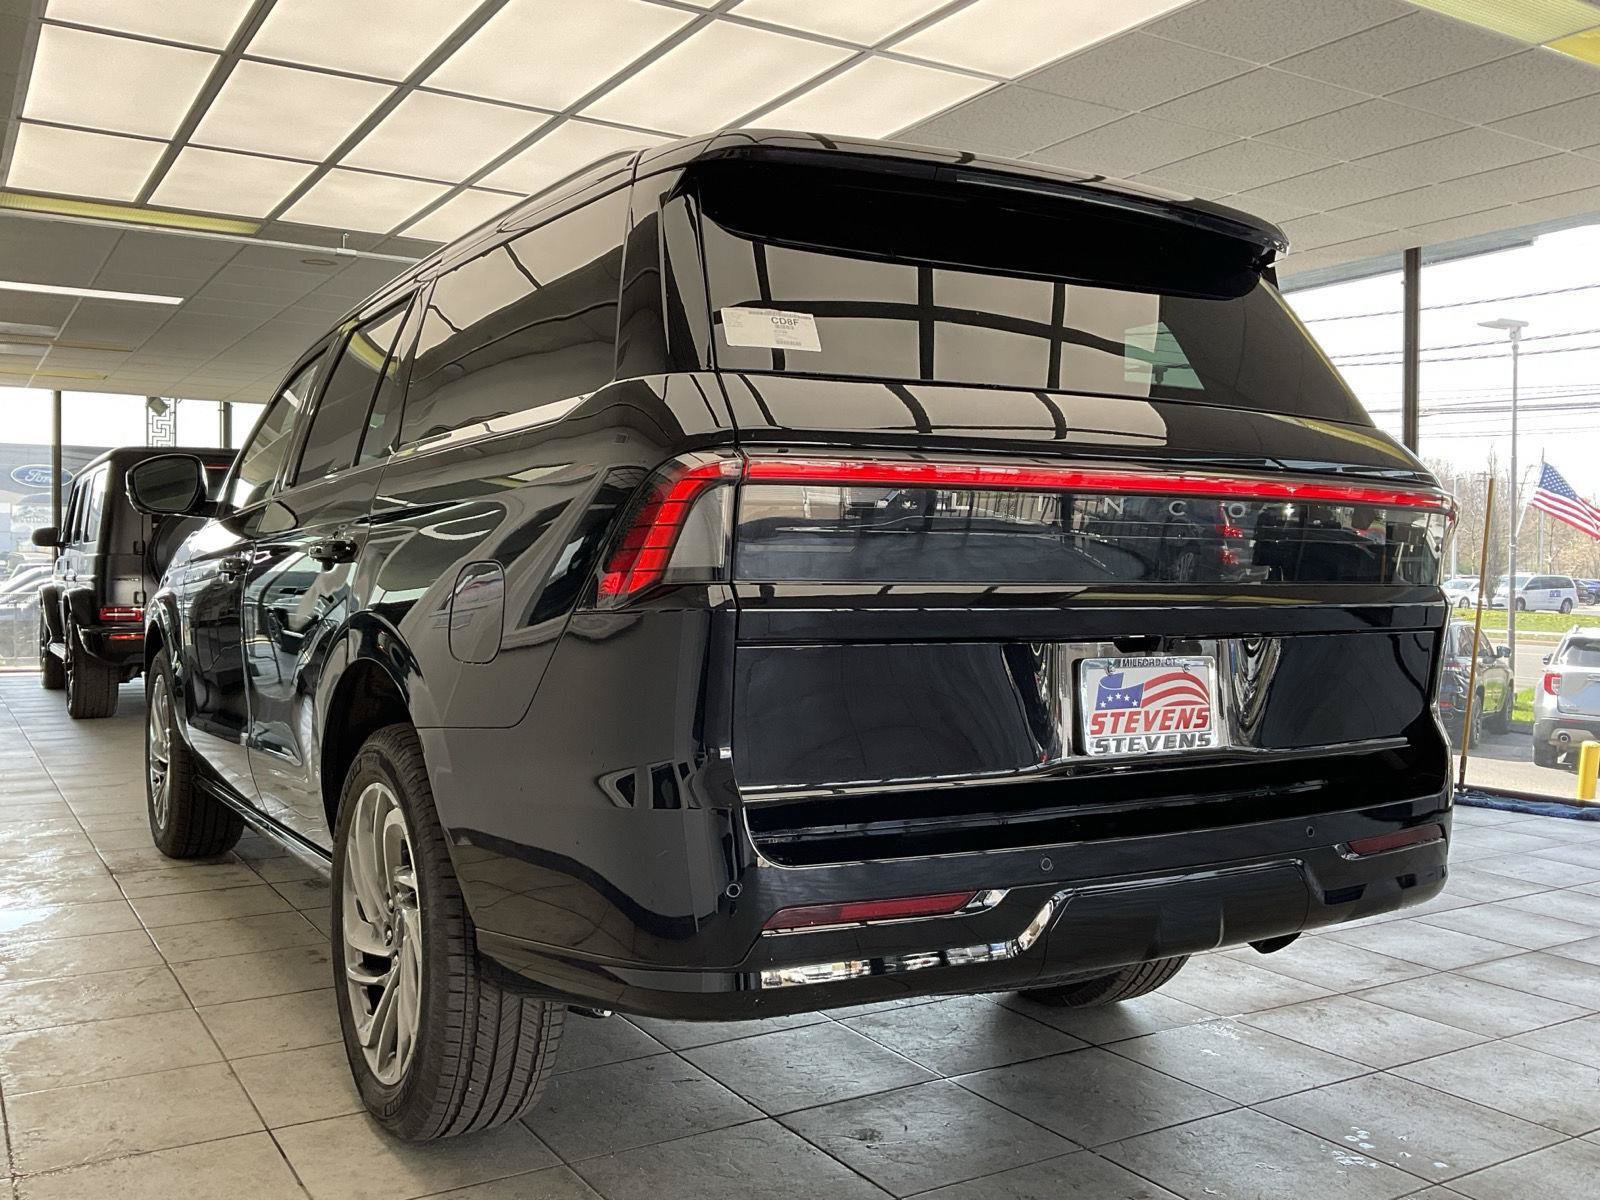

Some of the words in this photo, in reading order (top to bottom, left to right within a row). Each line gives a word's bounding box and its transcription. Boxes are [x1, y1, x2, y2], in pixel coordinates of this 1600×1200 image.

[770, 316, 799, 326] CD8F
[25, 469, 56, 483] For
[951, 492, 1354, 521] LINCO
[1090, 707, 1210, 736] STEVENS
[1095, 732, 1212, 754] STEVENS
